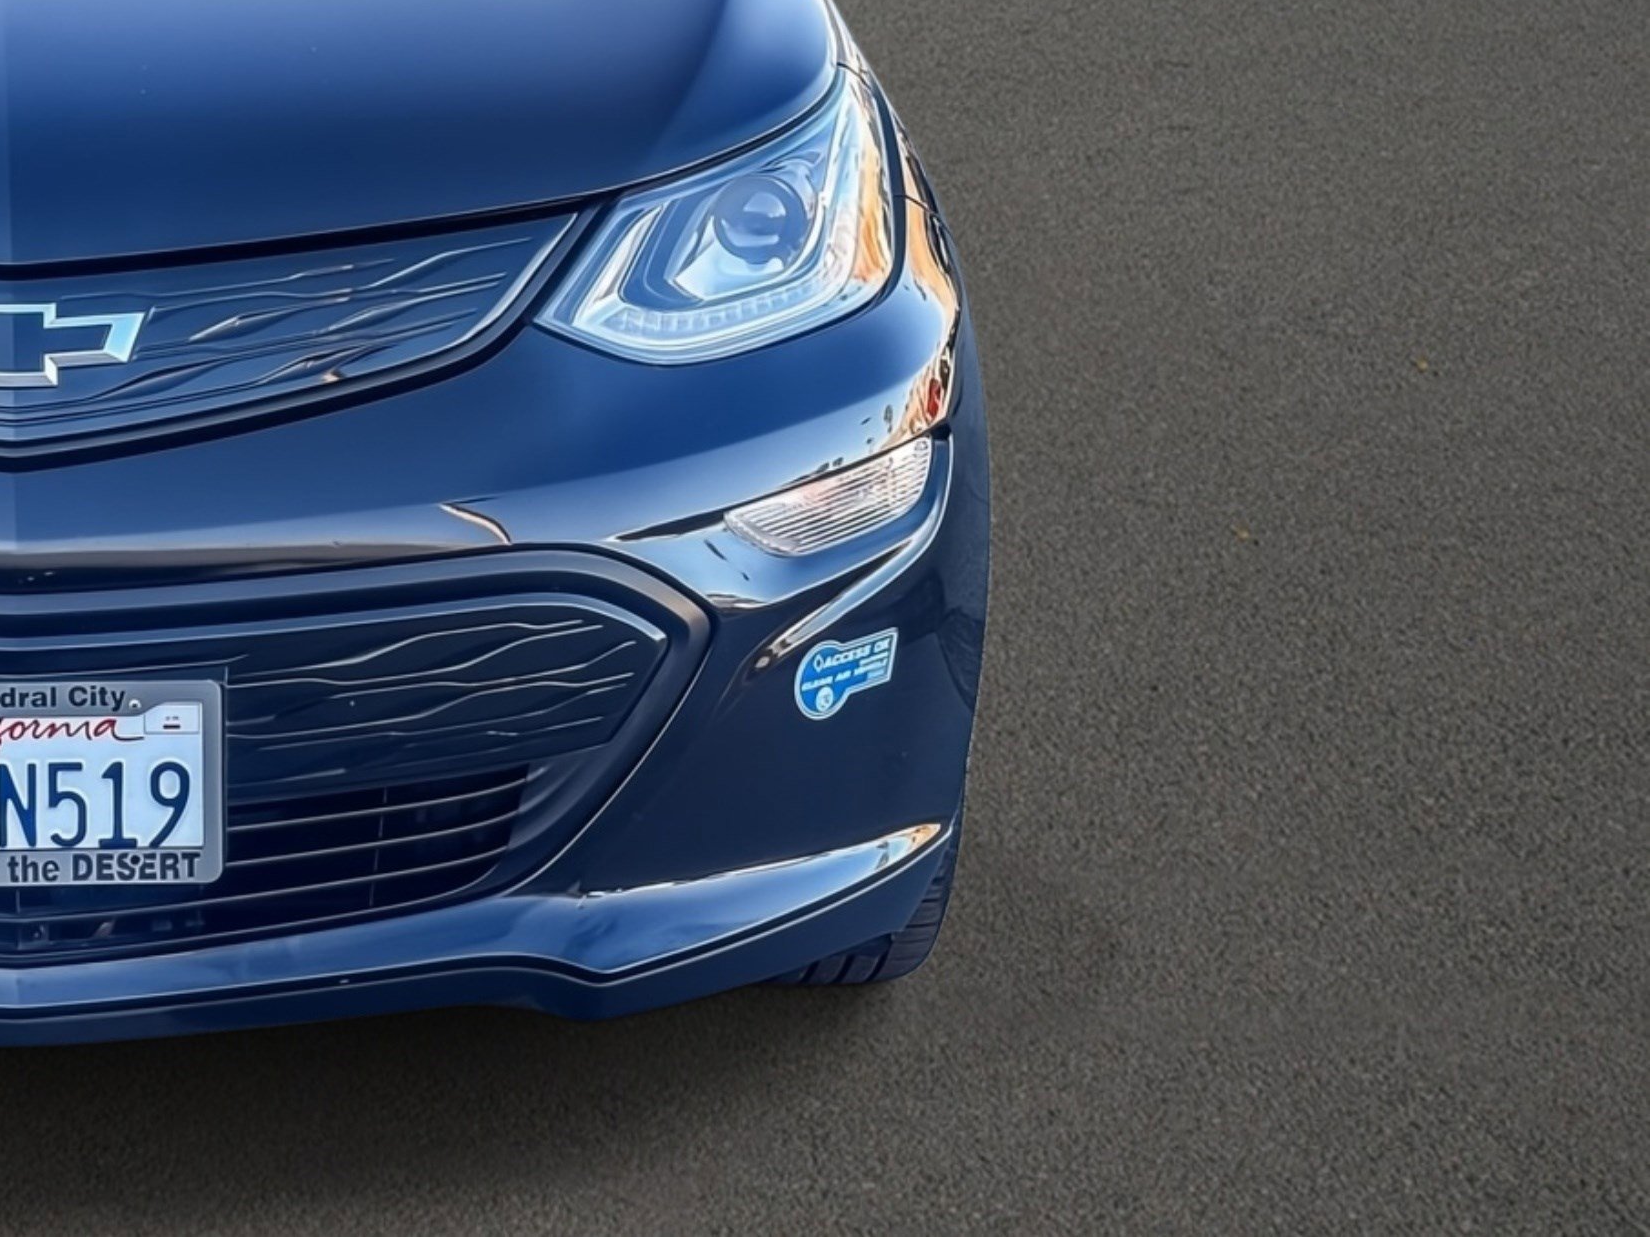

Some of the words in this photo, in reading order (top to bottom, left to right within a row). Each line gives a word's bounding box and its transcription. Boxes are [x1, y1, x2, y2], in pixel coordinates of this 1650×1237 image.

[68, 685, 125, 711] City
[8, 855, 60, 883] the
[72, 851, 201, 882] DESERT
